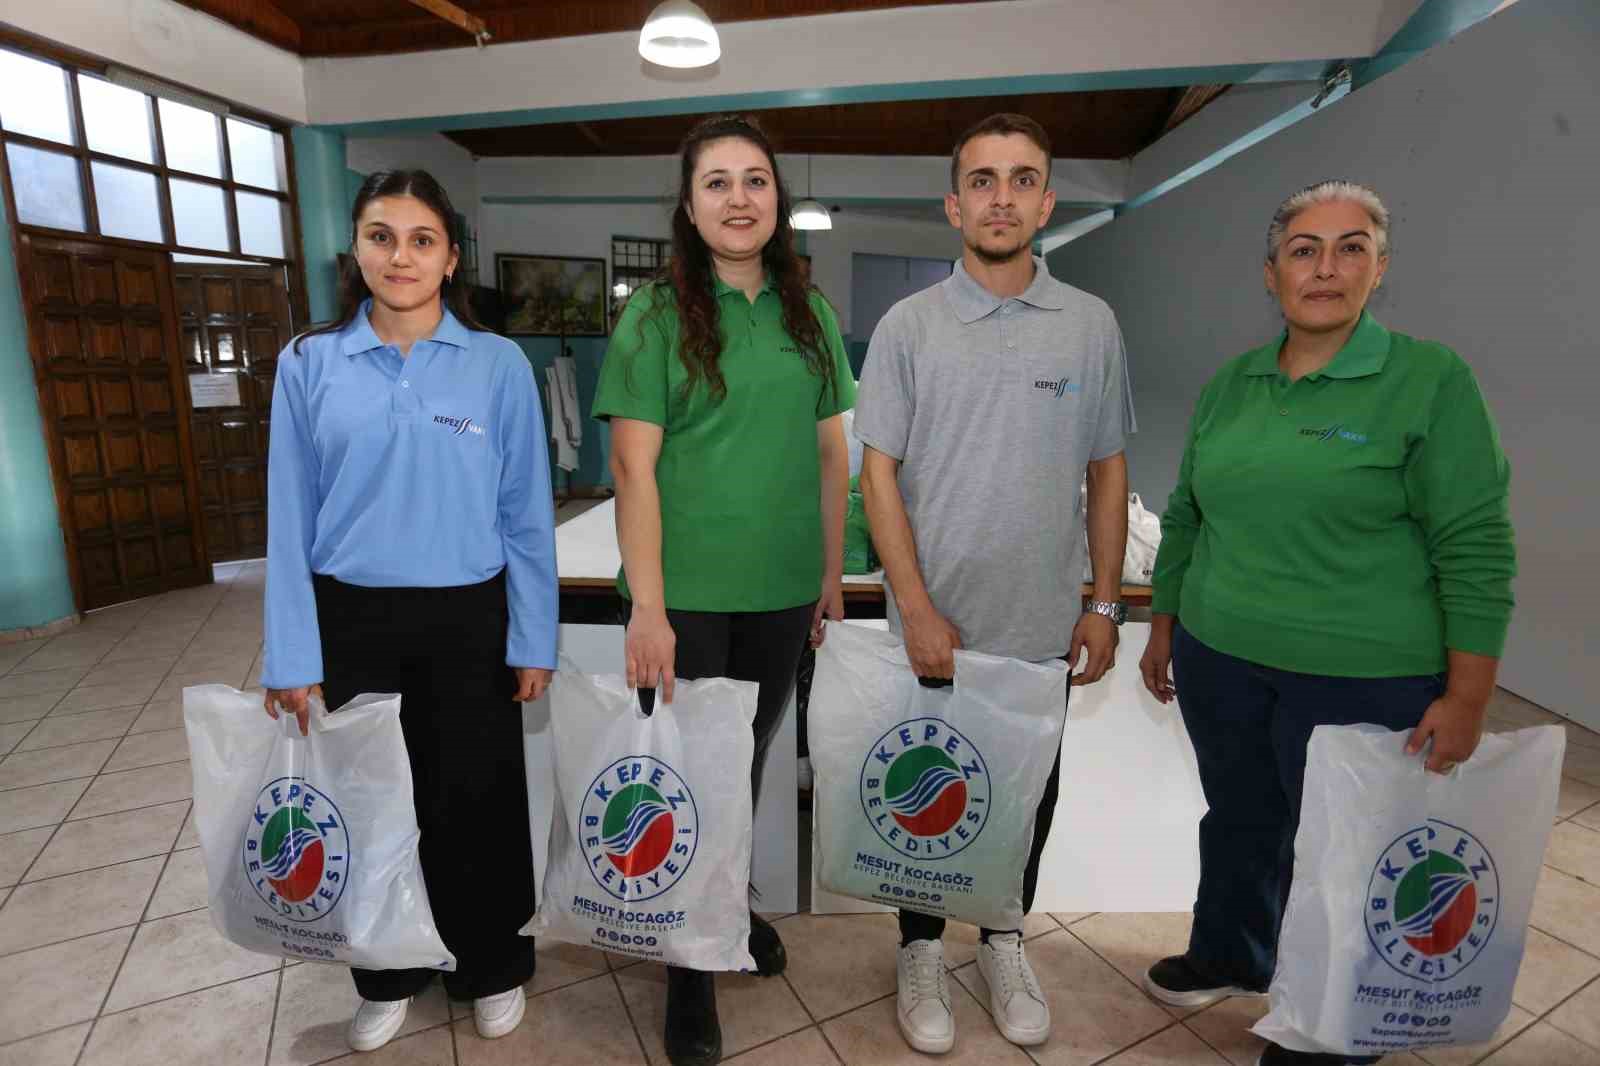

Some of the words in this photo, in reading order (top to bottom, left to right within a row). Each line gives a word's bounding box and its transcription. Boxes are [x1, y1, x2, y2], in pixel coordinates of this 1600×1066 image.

[433, 415, 460, 427] KEPEZ
[873, 723, 983, 781] KEPEZ
[254, 784, 338, 837] KEPEZ
[594, 762, 687, 811] KEPEZ
[866, 777, 986, 854] BELEDİYESİ
[246, 838, 343, 918] BELEDİYESİ
[856, 852, 902, 873] MESUT
[904, 866, 974, 887] KOCAGÖZ
[574, 895, 615, 917] MESUT
[618, 909, 686, 924] KOCAGÖZ
[1356, 984, 1411, 999] MESUT
